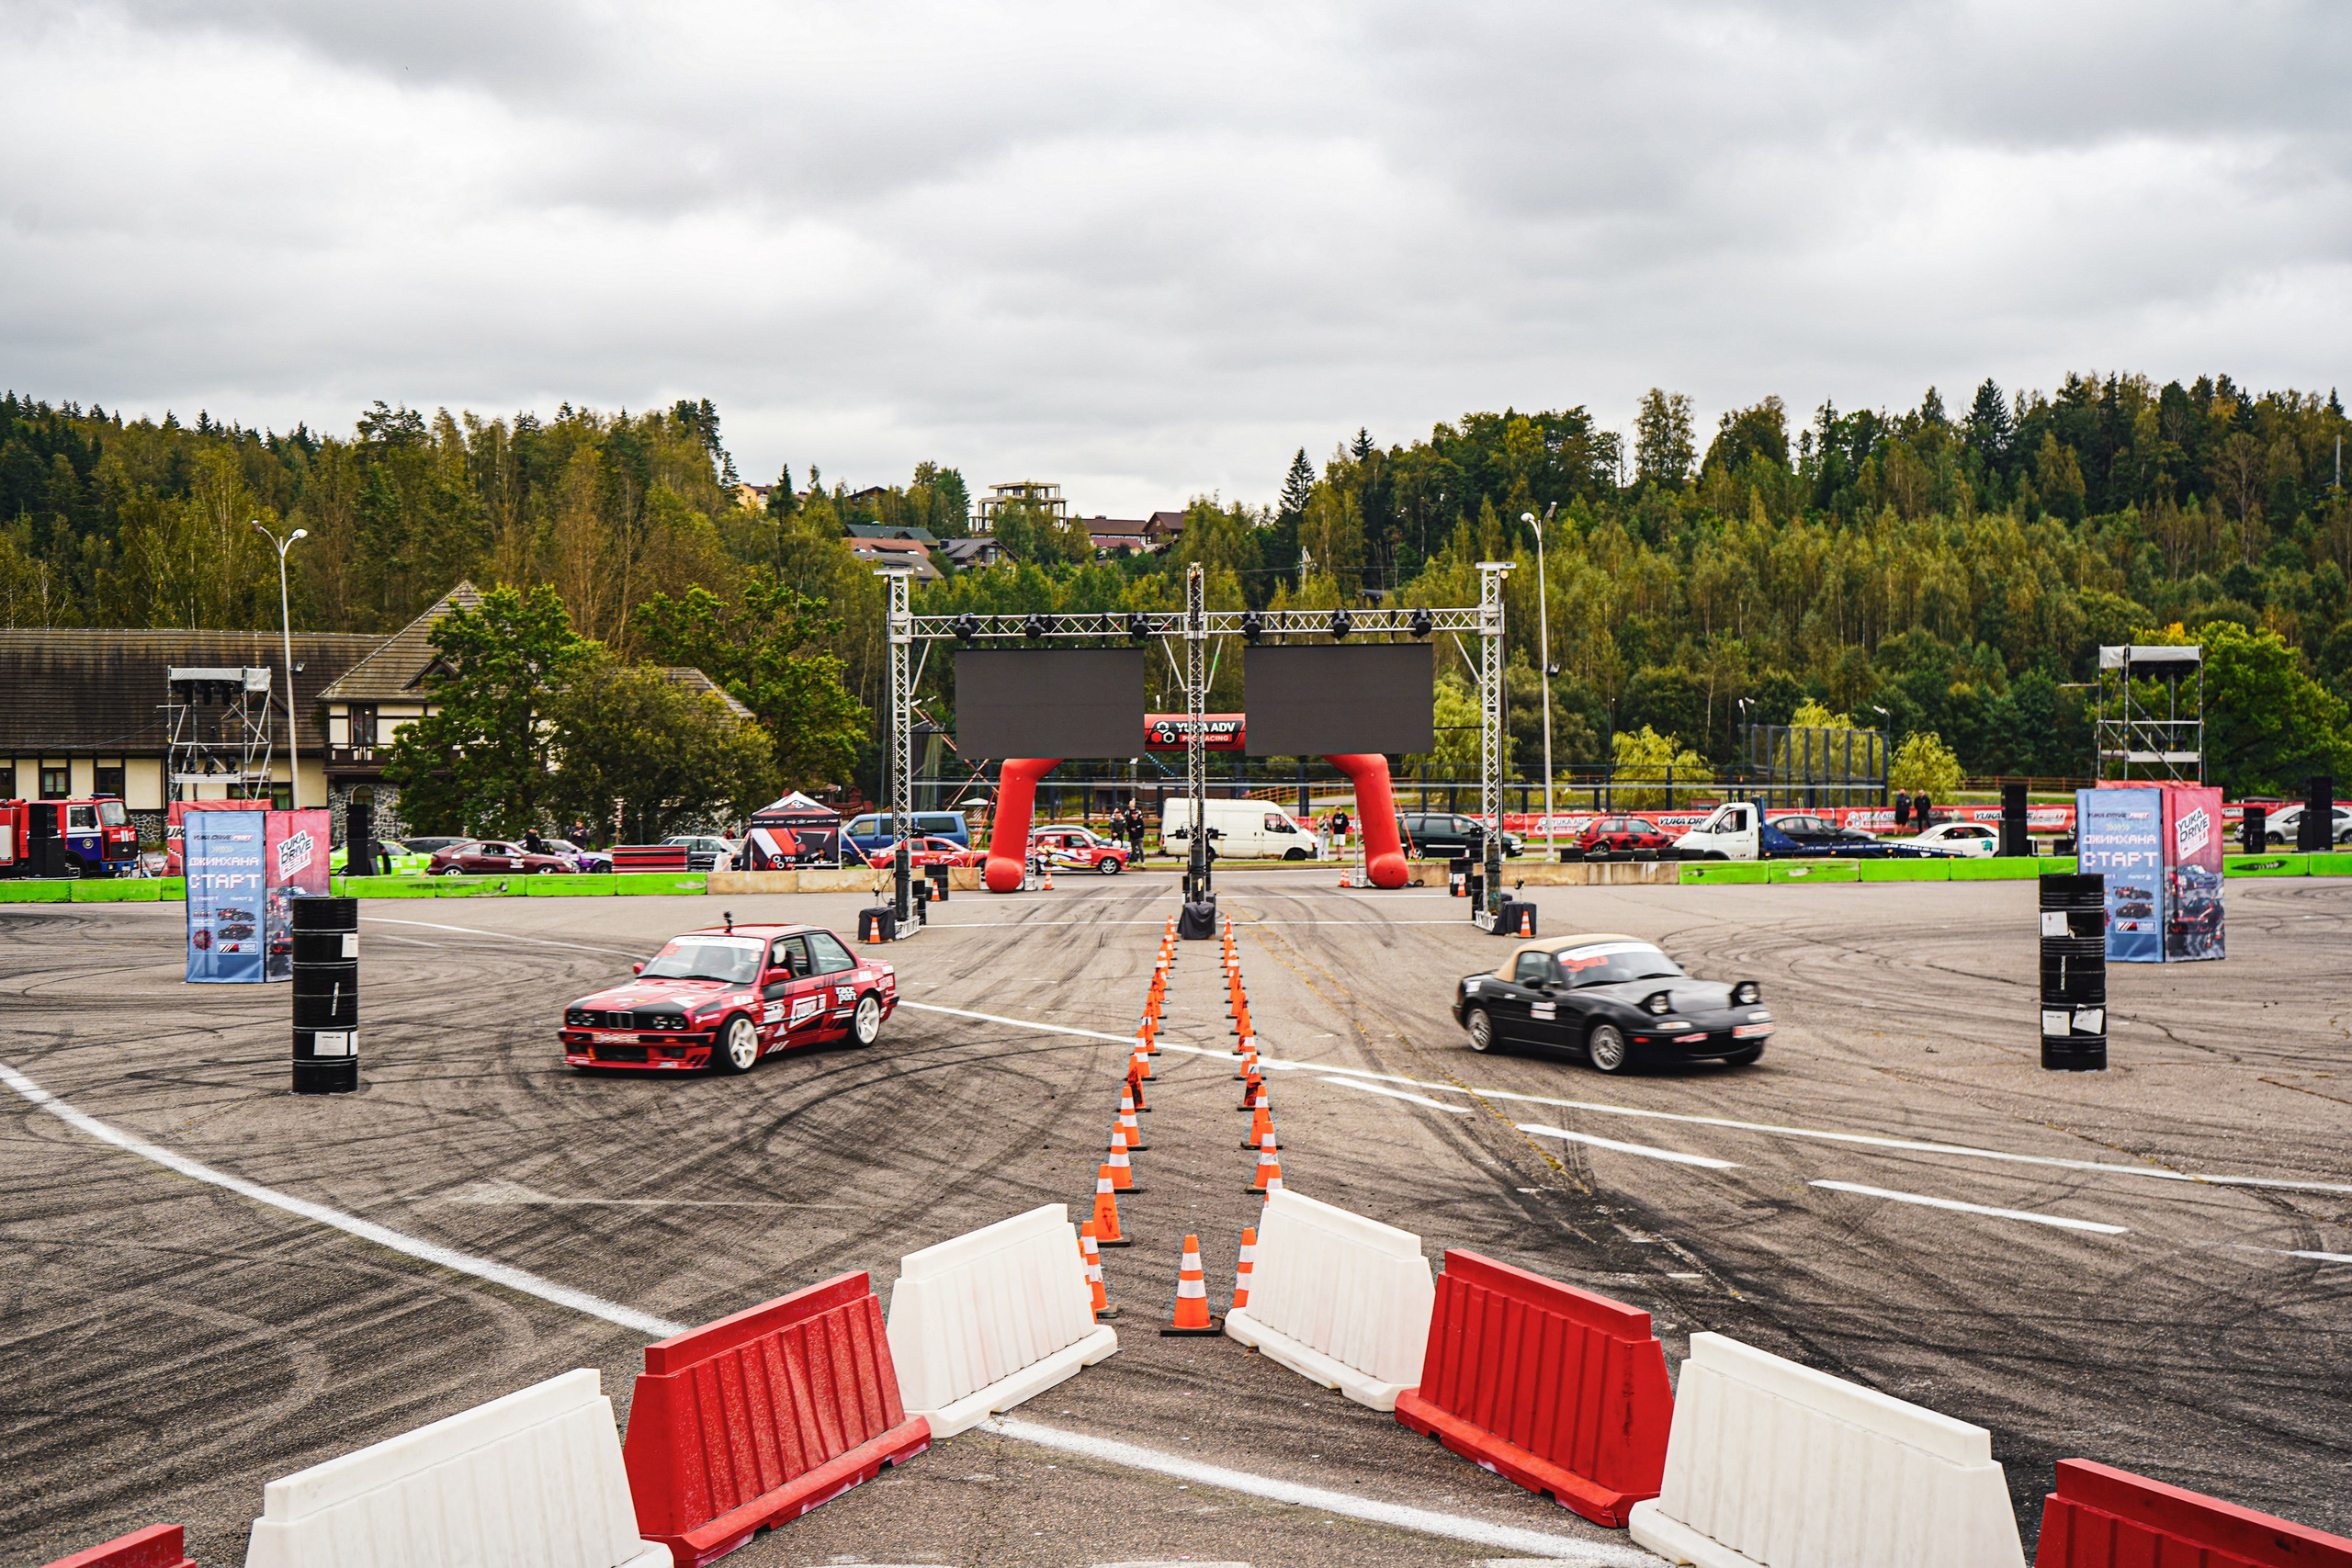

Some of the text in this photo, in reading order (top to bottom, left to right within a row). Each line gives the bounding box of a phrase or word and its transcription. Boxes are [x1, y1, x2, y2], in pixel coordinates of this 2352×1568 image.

[1176, 722, 1236, 733] YUA ADV
[1861, 812, 1881, 820] YUKA
[1975, 812, 2001, 820] YUKA
[2177, 809, 2202, 831] YUKA
[2180, 817, 2209, 842] DRIVE
[278, 832, 306, 853] YUKA
[2083, 834, 2157, 845] ДЖИМХАНА
[281, 839, 311, 864] DRIVE
[188, 856, 260, 866] ДЖИМХАНА
[2082, 852, 2159, 868] СТАРТ
[188, 874, 262, 890] СТАРТ
[835, 986, 855, 995] race
[837, 993, 858, 1005] port
